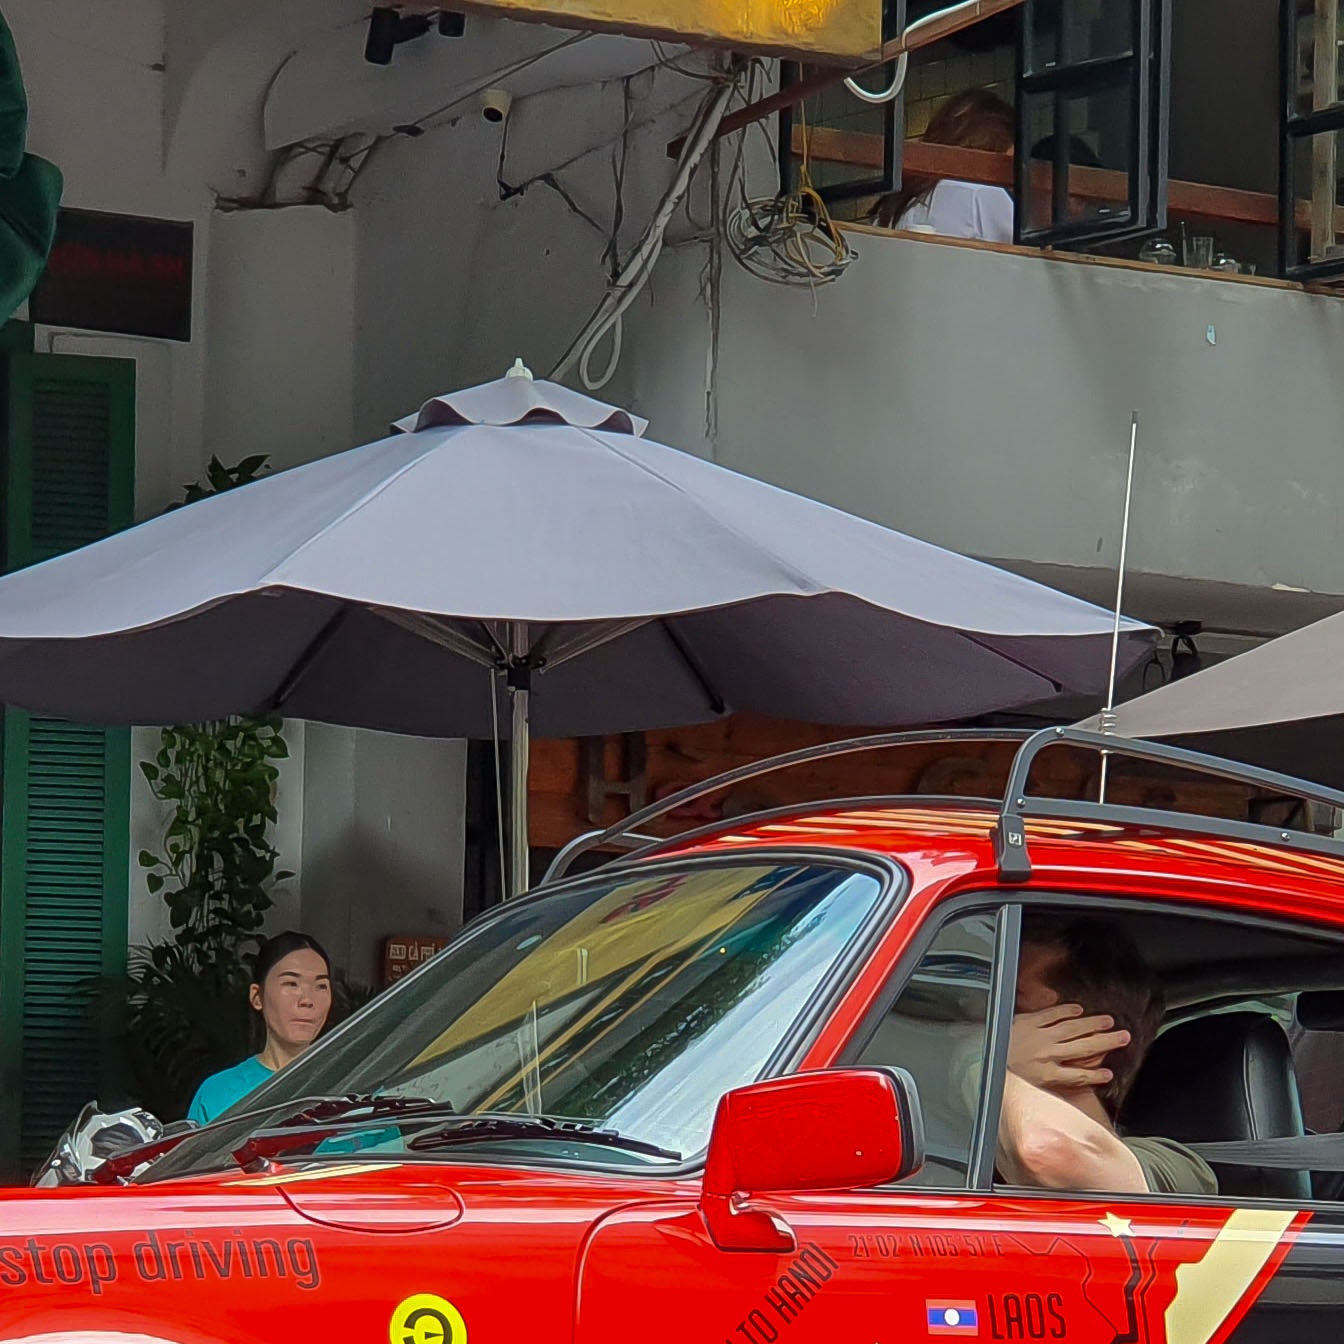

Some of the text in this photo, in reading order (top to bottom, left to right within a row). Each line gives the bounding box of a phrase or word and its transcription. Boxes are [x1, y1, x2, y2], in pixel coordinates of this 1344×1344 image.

[133, 1229, 321, 1290] driving
[765, 1241, 840, 1326] HANOI
[987, 1293, 1068, 1340] LAOS
